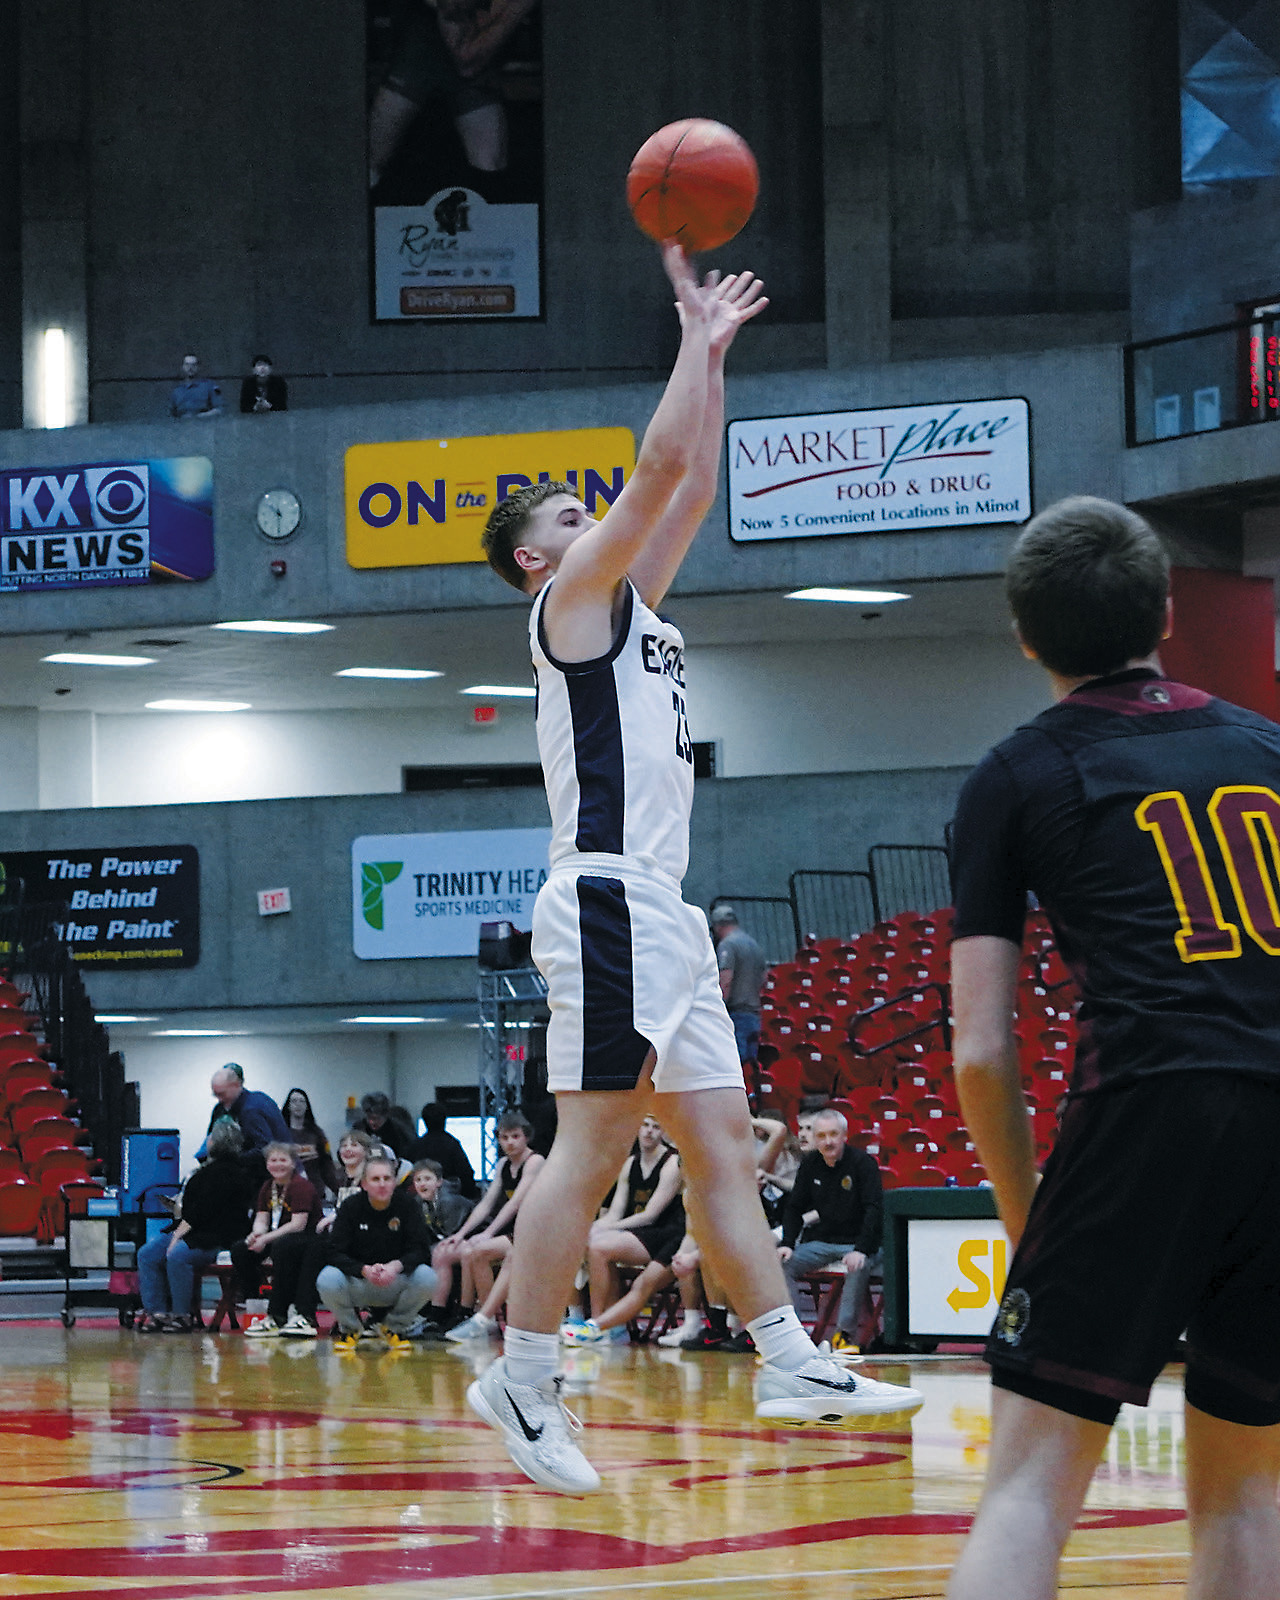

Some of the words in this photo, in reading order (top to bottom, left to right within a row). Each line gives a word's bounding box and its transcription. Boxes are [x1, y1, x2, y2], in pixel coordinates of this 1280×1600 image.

[399, 225, 459, 268] Ryan
[735, 424, 895, 469] MARKET
[9, 474, 80, 529] KX
[837, 480, 896, 500] FOOD
[906, 479, 921, 496] &
[930, 472, 991, 493] DRUG
[358, 479, 447, 528] ON
[456, 491, 487, 508] the
[741, 518, 773, 531] Now
[780, 515, 789, 528] 5
[795, 509, 875, 527] Convenient
[881, 503, 950, 521] Locations
[955, 500, 969, 514] in
[975, 498, 1019, 513] Minot
[8, 533, 144, 572] NEWS
[47, 860, 93, 880] The
[100, 857, 183, 877] Power
[413, 870, 502, 898] TRINITY
[1134, 785, 1280, 963] 10
[71, 887, 158, 910] Behind
[415, 901, 462, 917] SPORTS
[465, 899, 522, 915] MEDICINE
[106, 918, 174, 940] Paint
